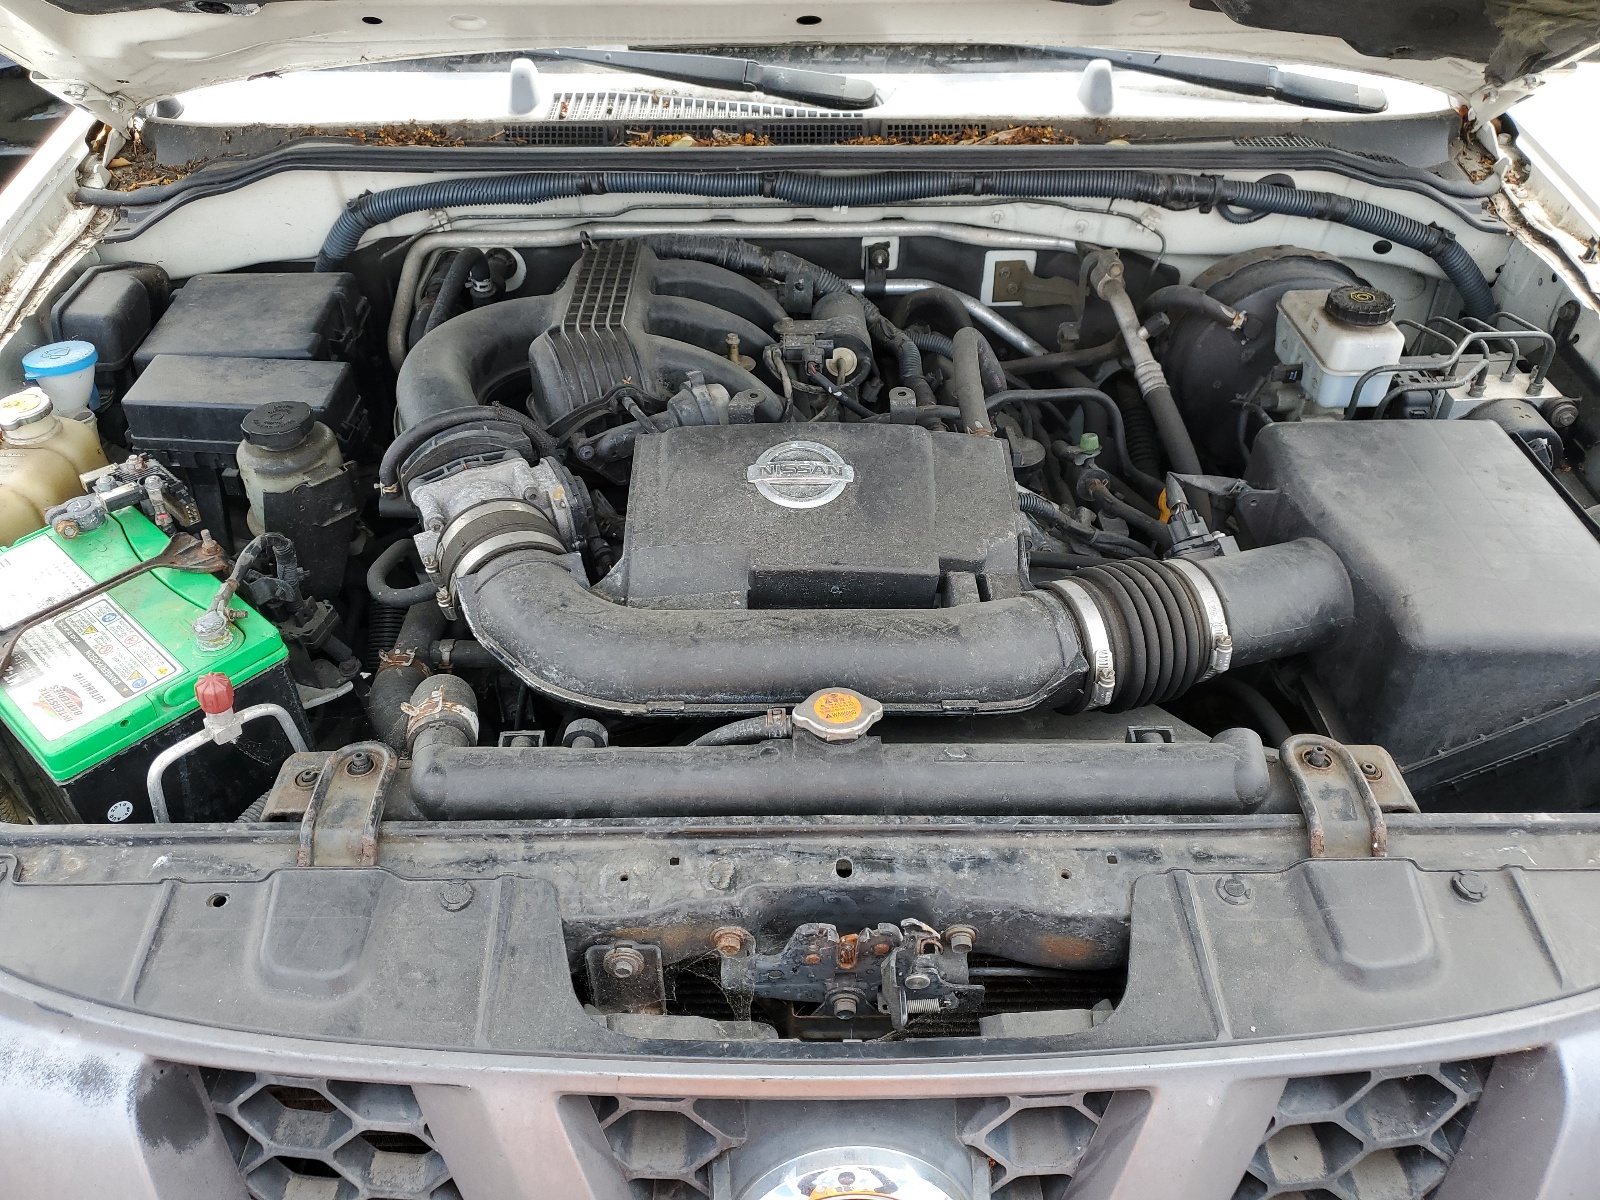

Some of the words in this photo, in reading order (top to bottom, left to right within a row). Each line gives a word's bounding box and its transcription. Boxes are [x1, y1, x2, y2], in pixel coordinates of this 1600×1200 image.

[759, 465, 843, 476] NISSAN
[50, 684, 83, 716] BATTERIES
[73, 672, 107, 703] AUTOMOTIVE
[38, 686, 73, 722] INTERSTATE
